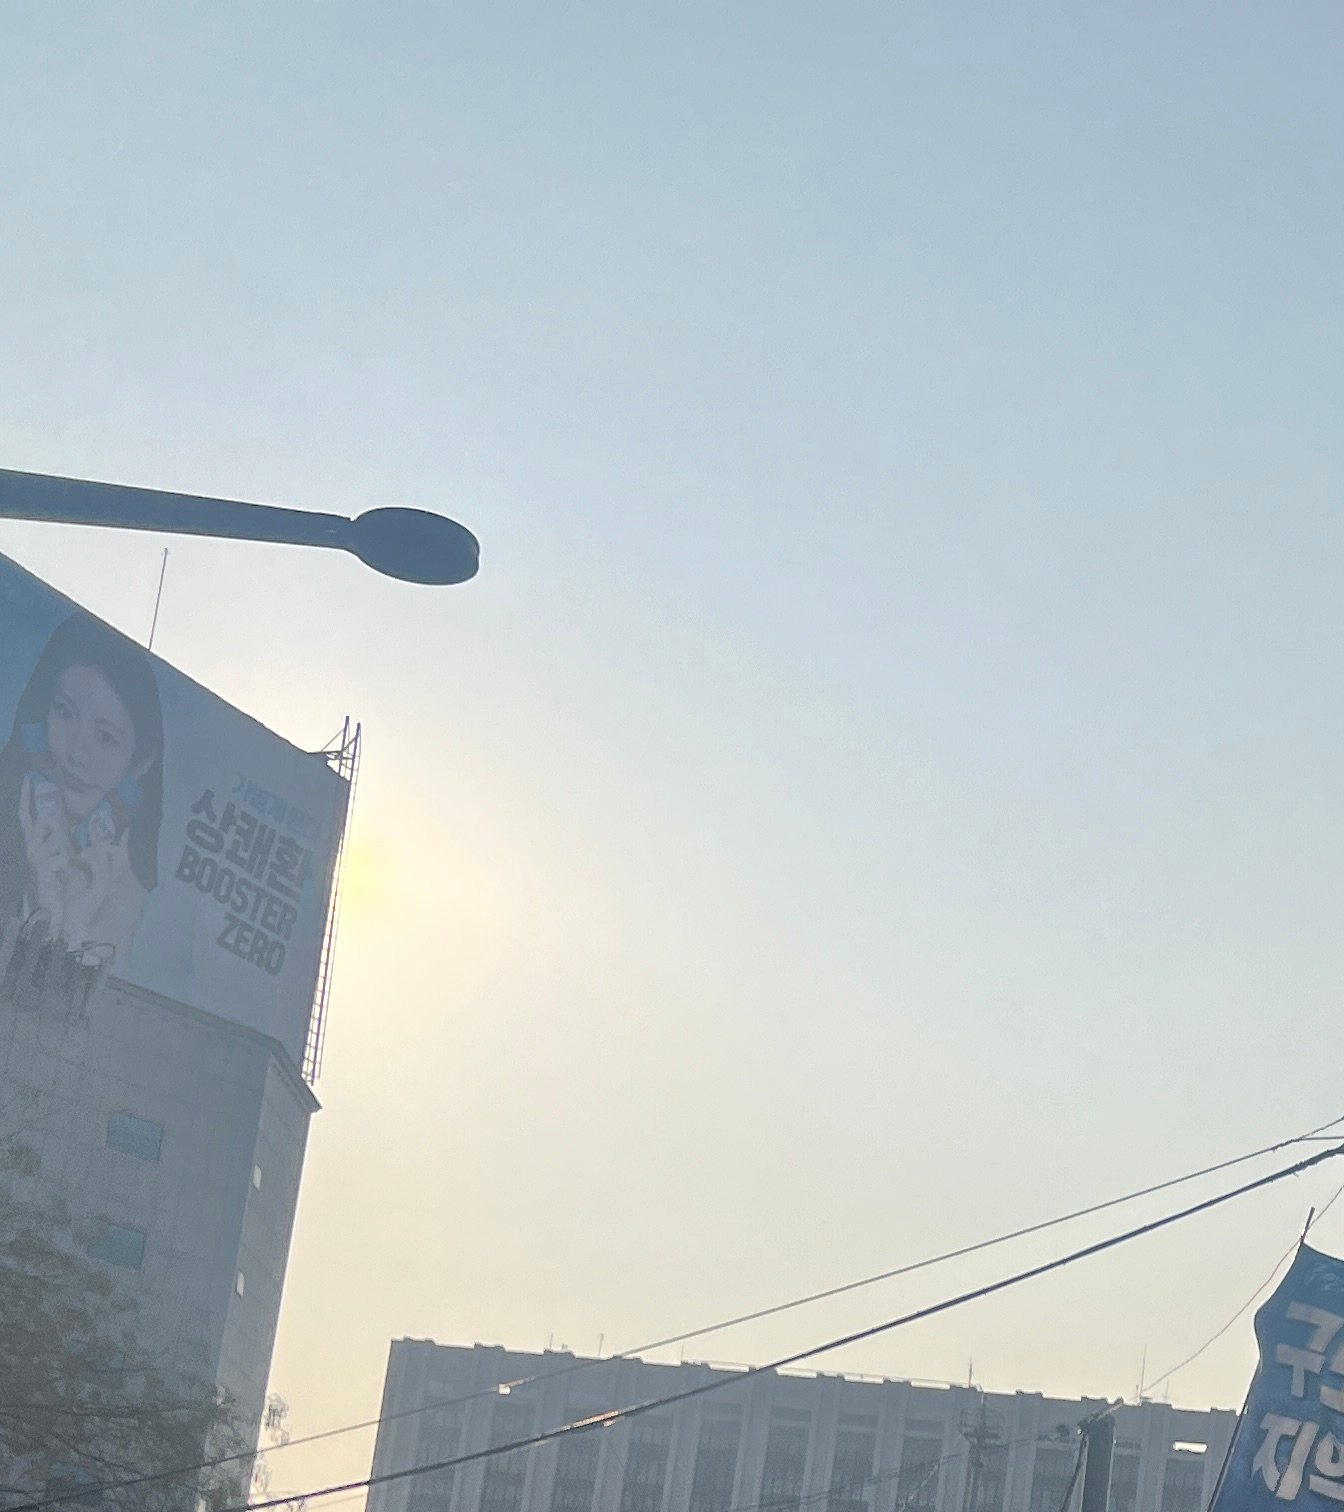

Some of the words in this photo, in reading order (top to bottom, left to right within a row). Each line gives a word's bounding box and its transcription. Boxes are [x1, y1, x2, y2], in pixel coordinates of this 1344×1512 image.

[175, 845, 298, 940] BOOSTER
[186, 788, 314, 902] 상쾌환
[216, 912, 286, 975] ZERO
